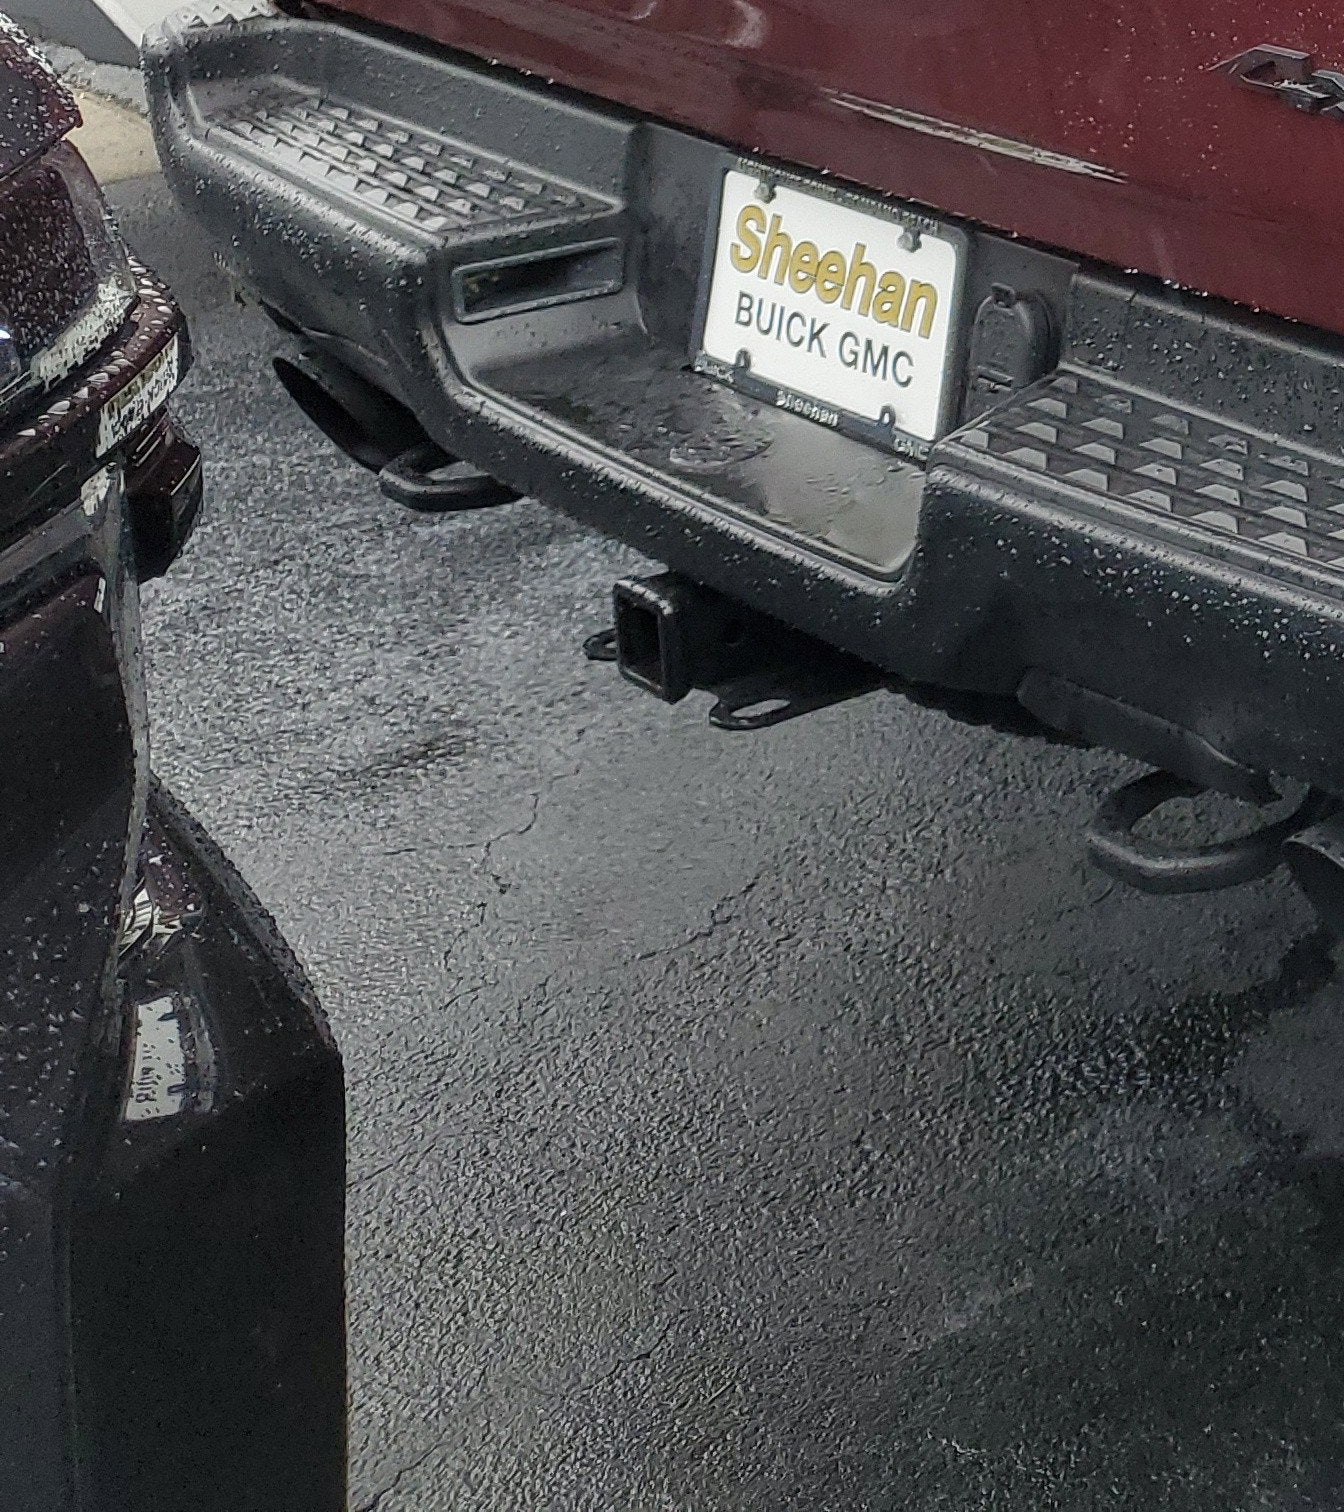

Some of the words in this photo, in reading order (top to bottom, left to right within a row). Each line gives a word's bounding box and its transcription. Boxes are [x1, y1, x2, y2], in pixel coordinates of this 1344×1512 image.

[730, 204, 938, 339] Sheehan
[735, 290, 830, 358] BUICK
[839, 331, 915, 388] GMC
